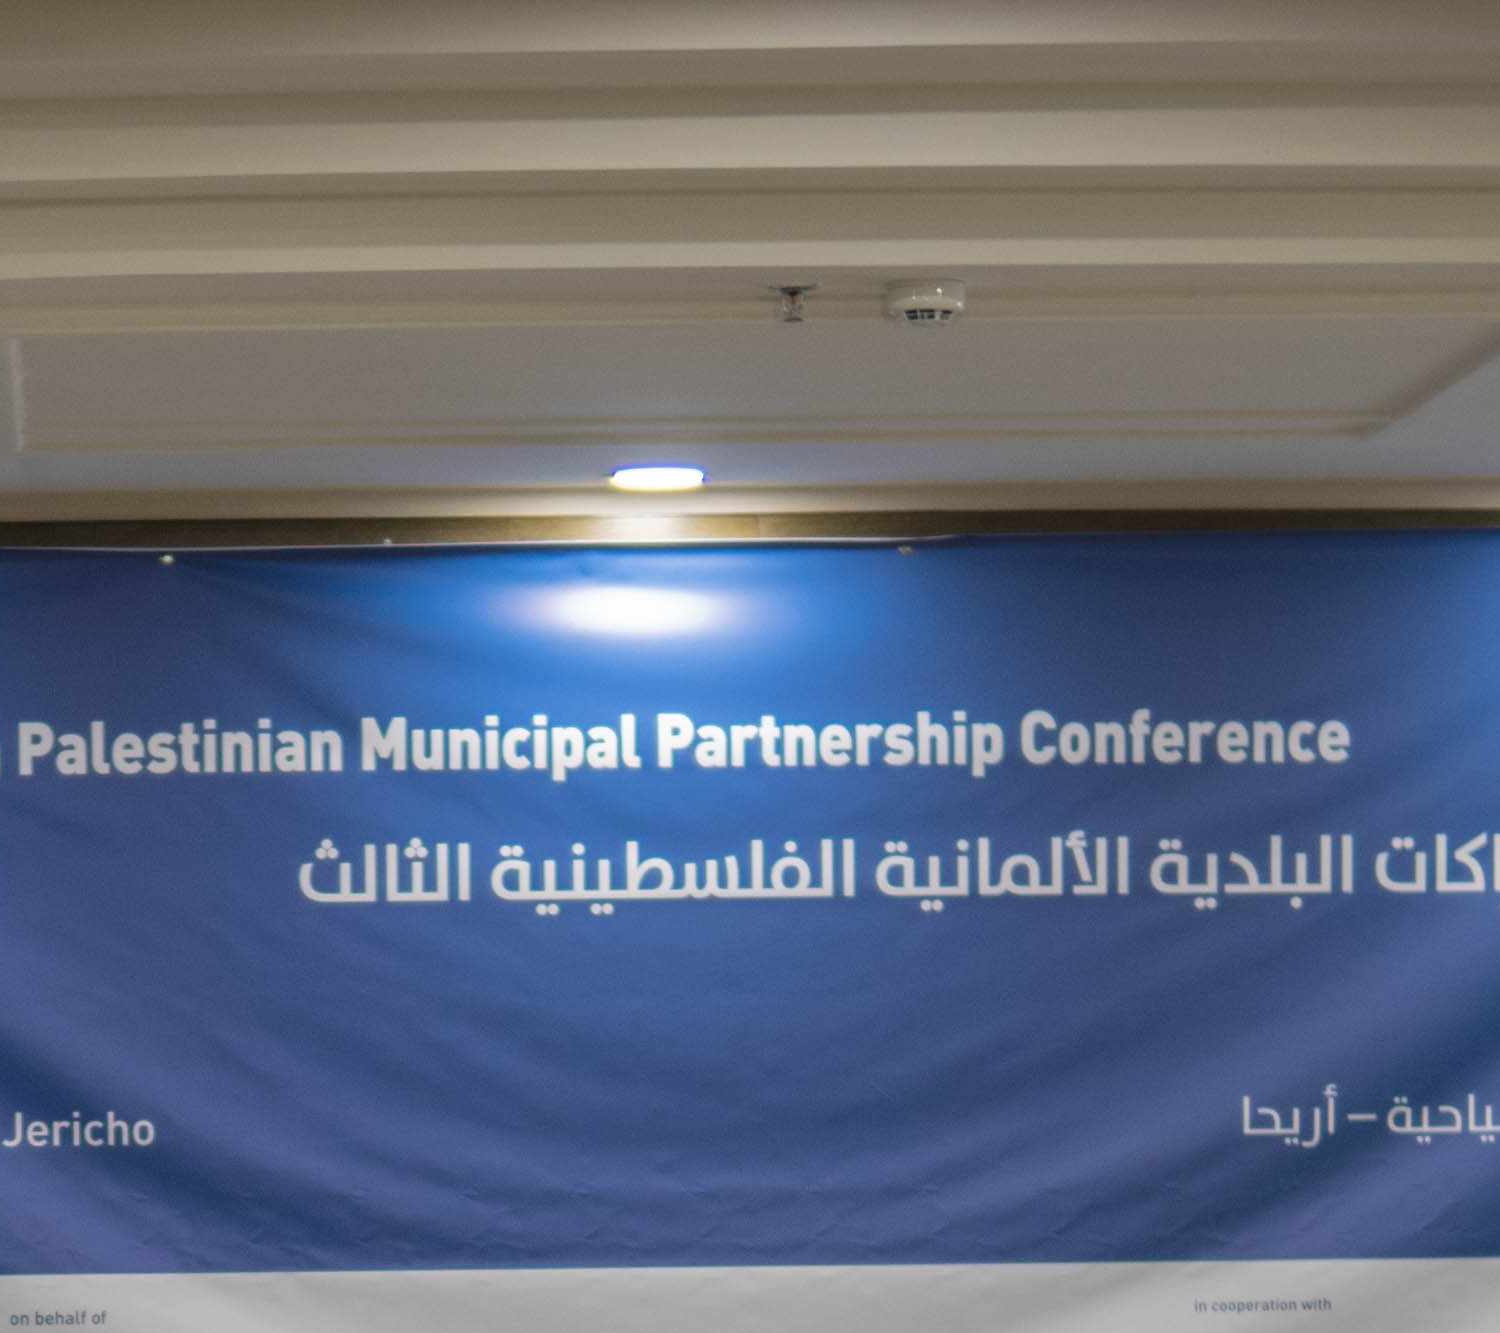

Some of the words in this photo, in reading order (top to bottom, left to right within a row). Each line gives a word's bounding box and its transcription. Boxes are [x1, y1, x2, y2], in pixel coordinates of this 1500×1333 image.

[18, 717, 344, 776] Palestinian
[362, 712, 642, 782] Municipal
[655, 710, 1003, 776] Partnership
[1020, 708, 1351, 765] Conference
[299, 836, 471, 903] الثالث
[490, 838, 855, 916] الفلسطينية
[874, 829, 1129, 912] الألمانية
[1149, 833, 1354, 910] البلدية
[0, 1110, 156, 1149] Jericho
[1241, 1083, 1338, 1148] أريحا
[9, 1314, 30, 1327] on
[34, 1310, 87, 1327] behalf
[90, 1310, 107, 1326] of
[1193, 1299, 1208, 1313] in
[1211, 1299, 1299, 1315] cooperation
[1301, 1297, 1333, 1311] with
